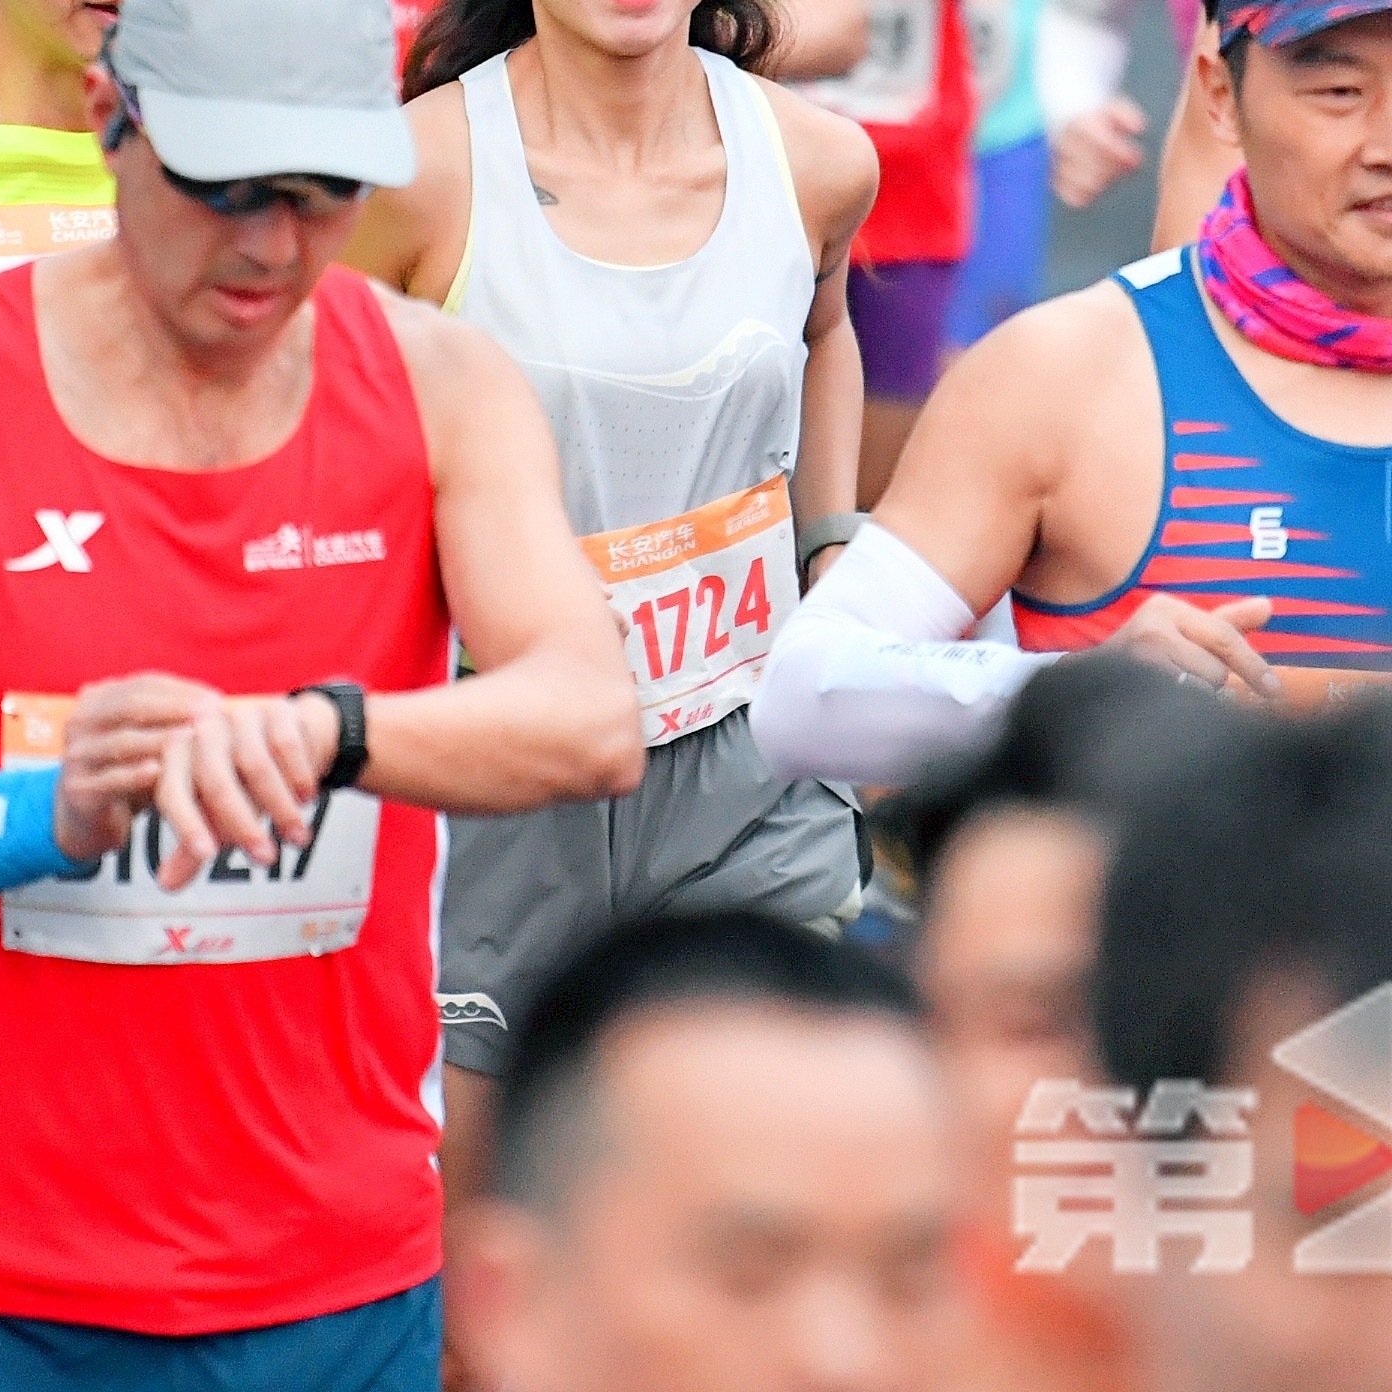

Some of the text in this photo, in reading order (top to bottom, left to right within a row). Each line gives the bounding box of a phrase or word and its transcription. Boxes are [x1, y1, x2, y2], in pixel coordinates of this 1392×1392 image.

[608, 521, 696, 560] 长安汽车
[609, 539, 696, 573] CHANGAN
[630, 557, 772, 684] 1724
